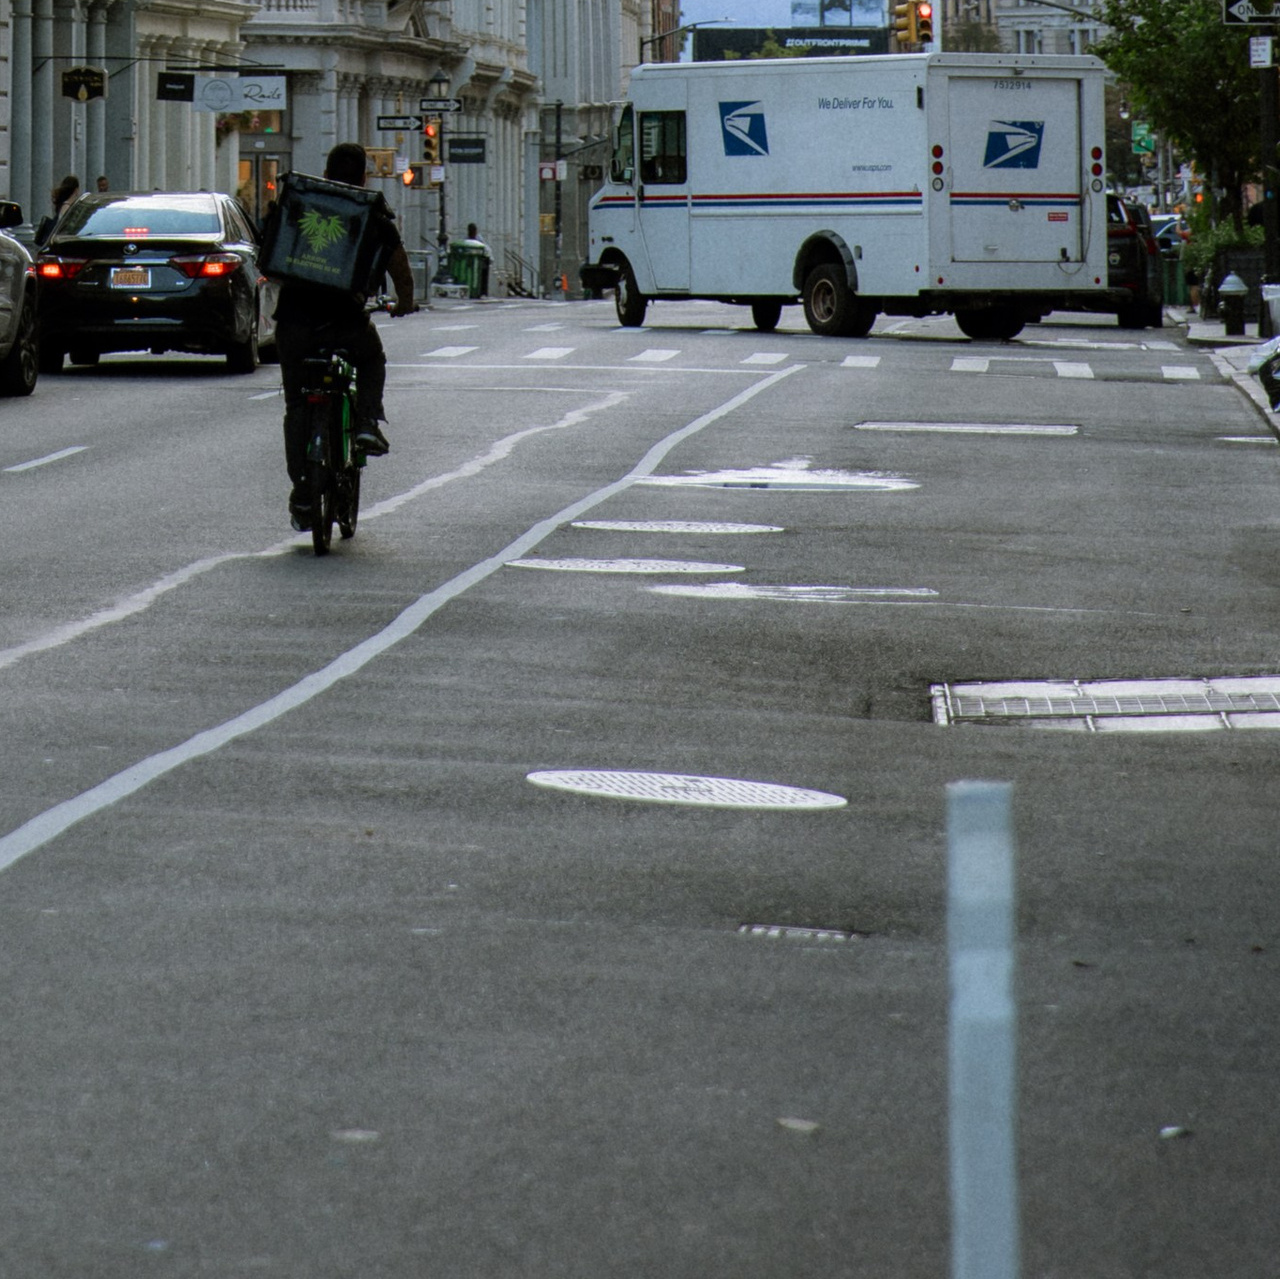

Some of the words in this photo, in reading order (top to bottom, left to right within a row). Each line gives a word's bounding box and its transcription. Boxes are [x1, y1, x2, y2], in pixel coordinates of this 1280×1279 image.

[1238, 4, 1262, 16] ON
[243, 84, 282, 103] Rails
[818, 97, 830, 110] We
[832, 97, 861, 110] Deliver
[862, 97, 877, 109] For
[877, 97, 894, 109] You.
